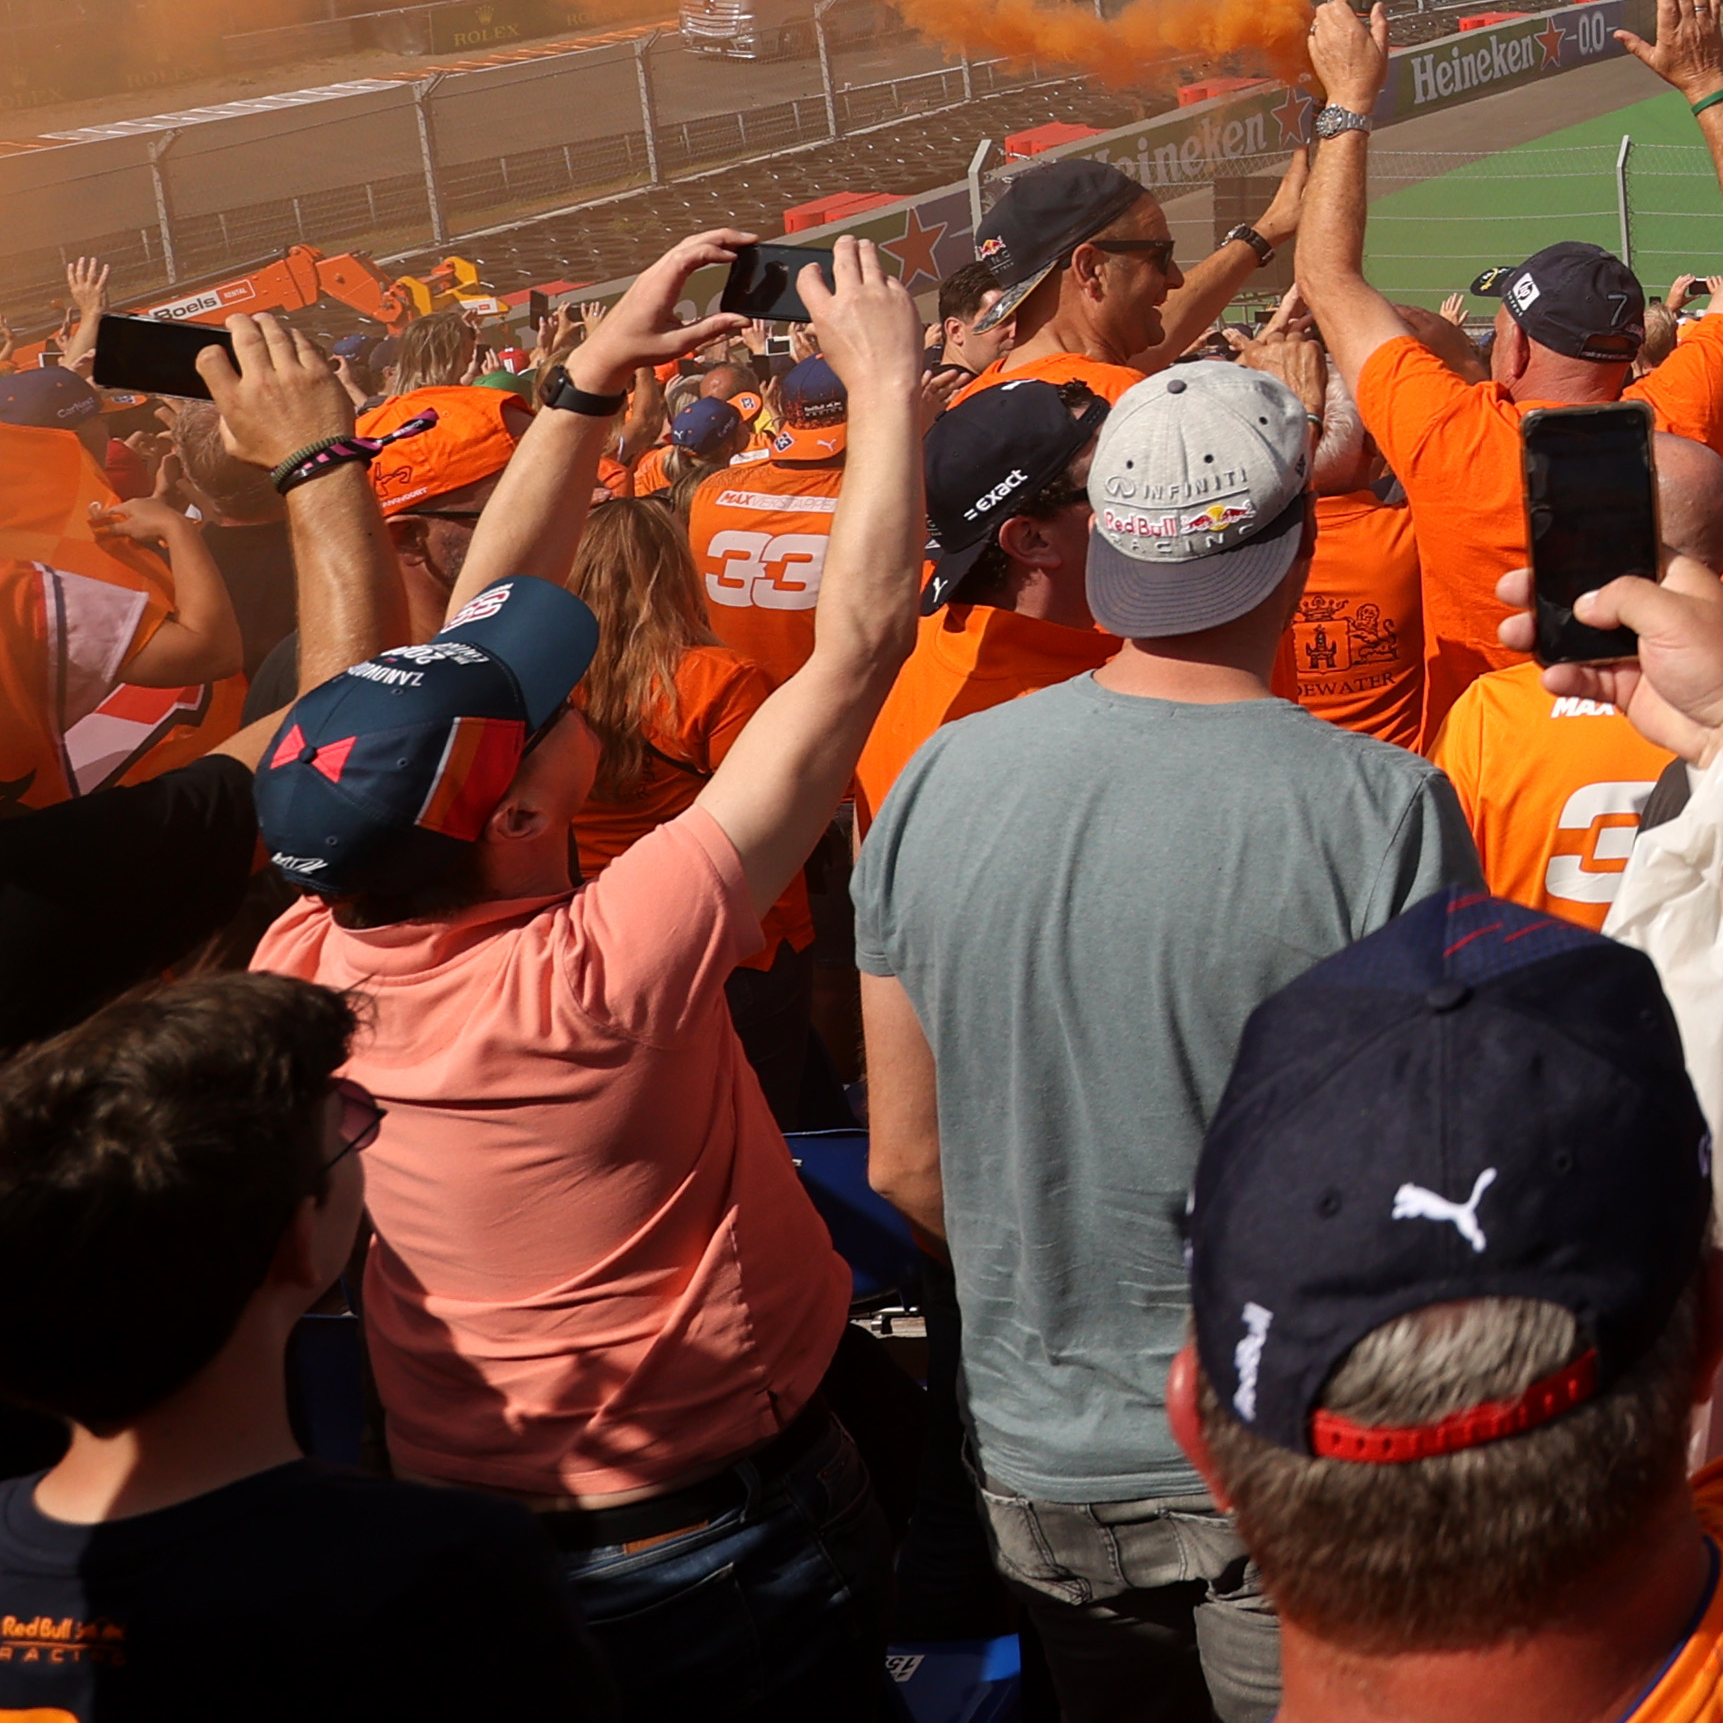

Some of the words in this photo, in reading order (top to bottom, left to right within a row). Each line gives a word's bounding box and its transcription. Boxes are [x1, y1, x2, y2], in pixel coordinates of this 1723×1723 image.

[454, 24, 520, 47] ROLEX
[1411, 34, 1536, 105] Heineken
[154, 295, 218, 322] Boels
[1606, 294, 1629, 327] 7
[1142, 467, 1249, 501] INFINITI
[720, 491, 838, 514] MAXVERSTAPPE
[705, 530, 830, 610] 33
[2, 1614, 40, 1637] Red
[40, 1617, 74, 1640] Bull
